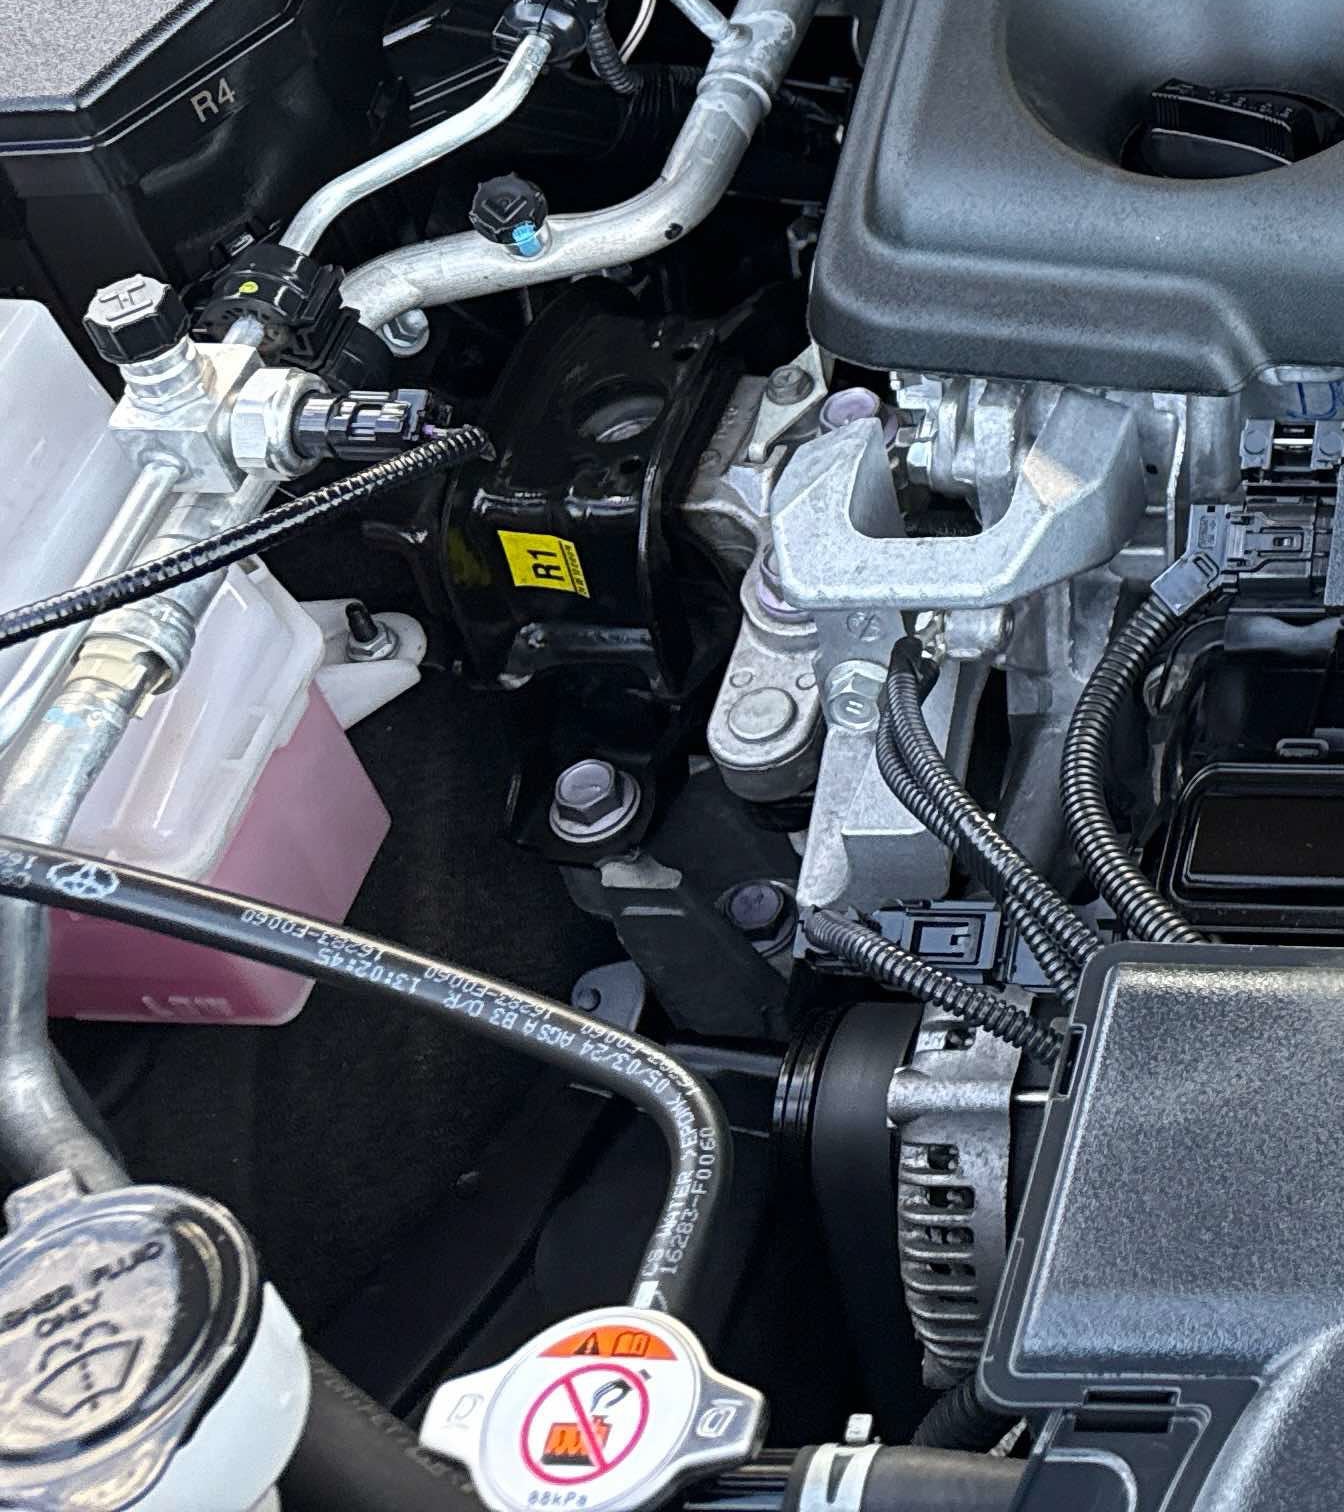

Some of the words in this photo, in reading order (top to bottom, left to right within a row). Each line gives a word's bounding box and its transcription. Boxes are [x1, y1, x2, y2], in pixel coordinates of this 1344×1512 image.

[190, 77, 238, 124] R4
[530, 546, 559, 584] R1
[317, 947, 422, 995] 13:02:45
[579, 1039, 671, 1095] 05/03/24
[658, 1126, 718, 1276] 16283-F0060
